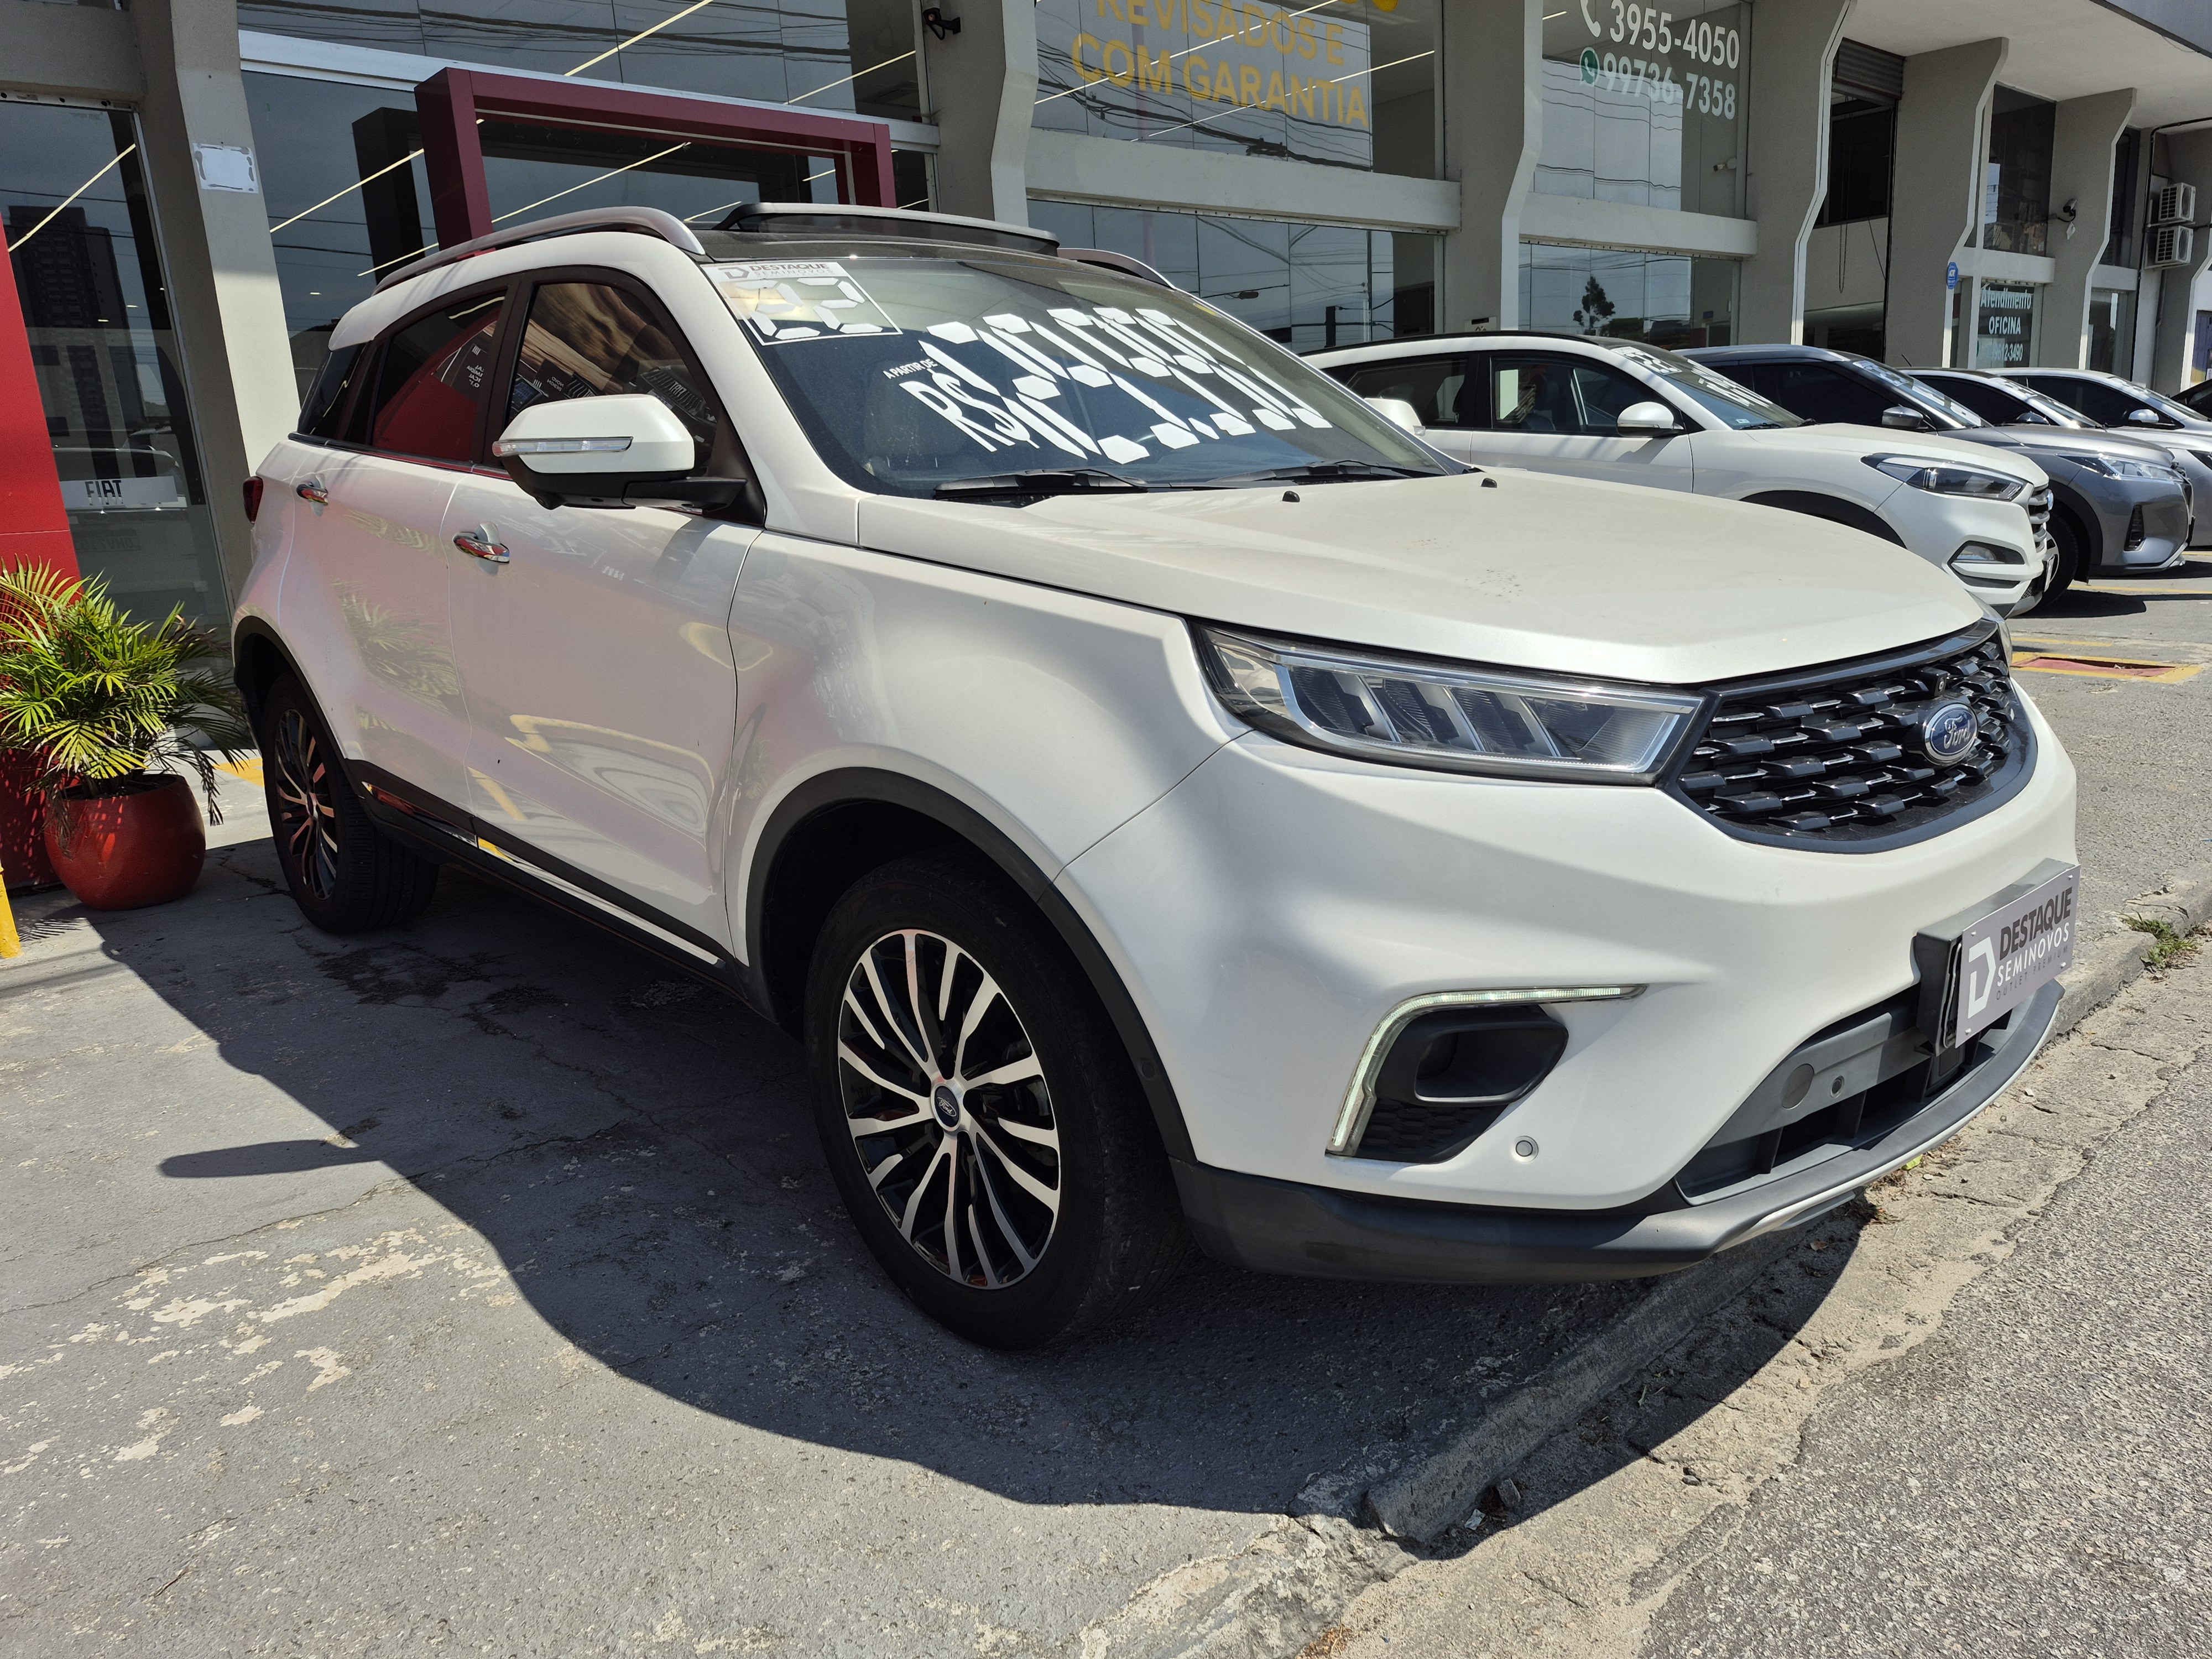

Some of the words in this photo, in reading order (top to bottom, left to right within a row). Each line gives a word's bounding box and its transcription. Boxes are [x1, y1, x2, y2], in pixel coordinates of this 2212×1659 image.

[1326, 24, 1344, 66] E
[1610, 0, 1740, 69] 3955-4050
[1071, 33, 1173, 95] COM
[1183, 54, 1369, 128] GARANTIA
[1603, 52, 1736, 120] 99736-7358
[734, 277, 883, 340] 22
[1980, 288, 2032, 310] Atendimento
[1989, 316, 2021, 335] OFICINA
[883, 371, 896, 379] A
[889, 362, 926, 377] PARTIR
[919, 358, 938, 368] DE
[85, 479, 124, 505] FIAT
[1943, 715, 1971, 749] Ford
[1999, 886, 2073, 961] DESTAQUE
[1996, 972, 2028, 1000] OUTLET
[2032, 945, 2068, 976] PREMIUM
[1997, 922, 2070, 987] SEMINOVOS
[938, 1099, 953, 1115] Ford
